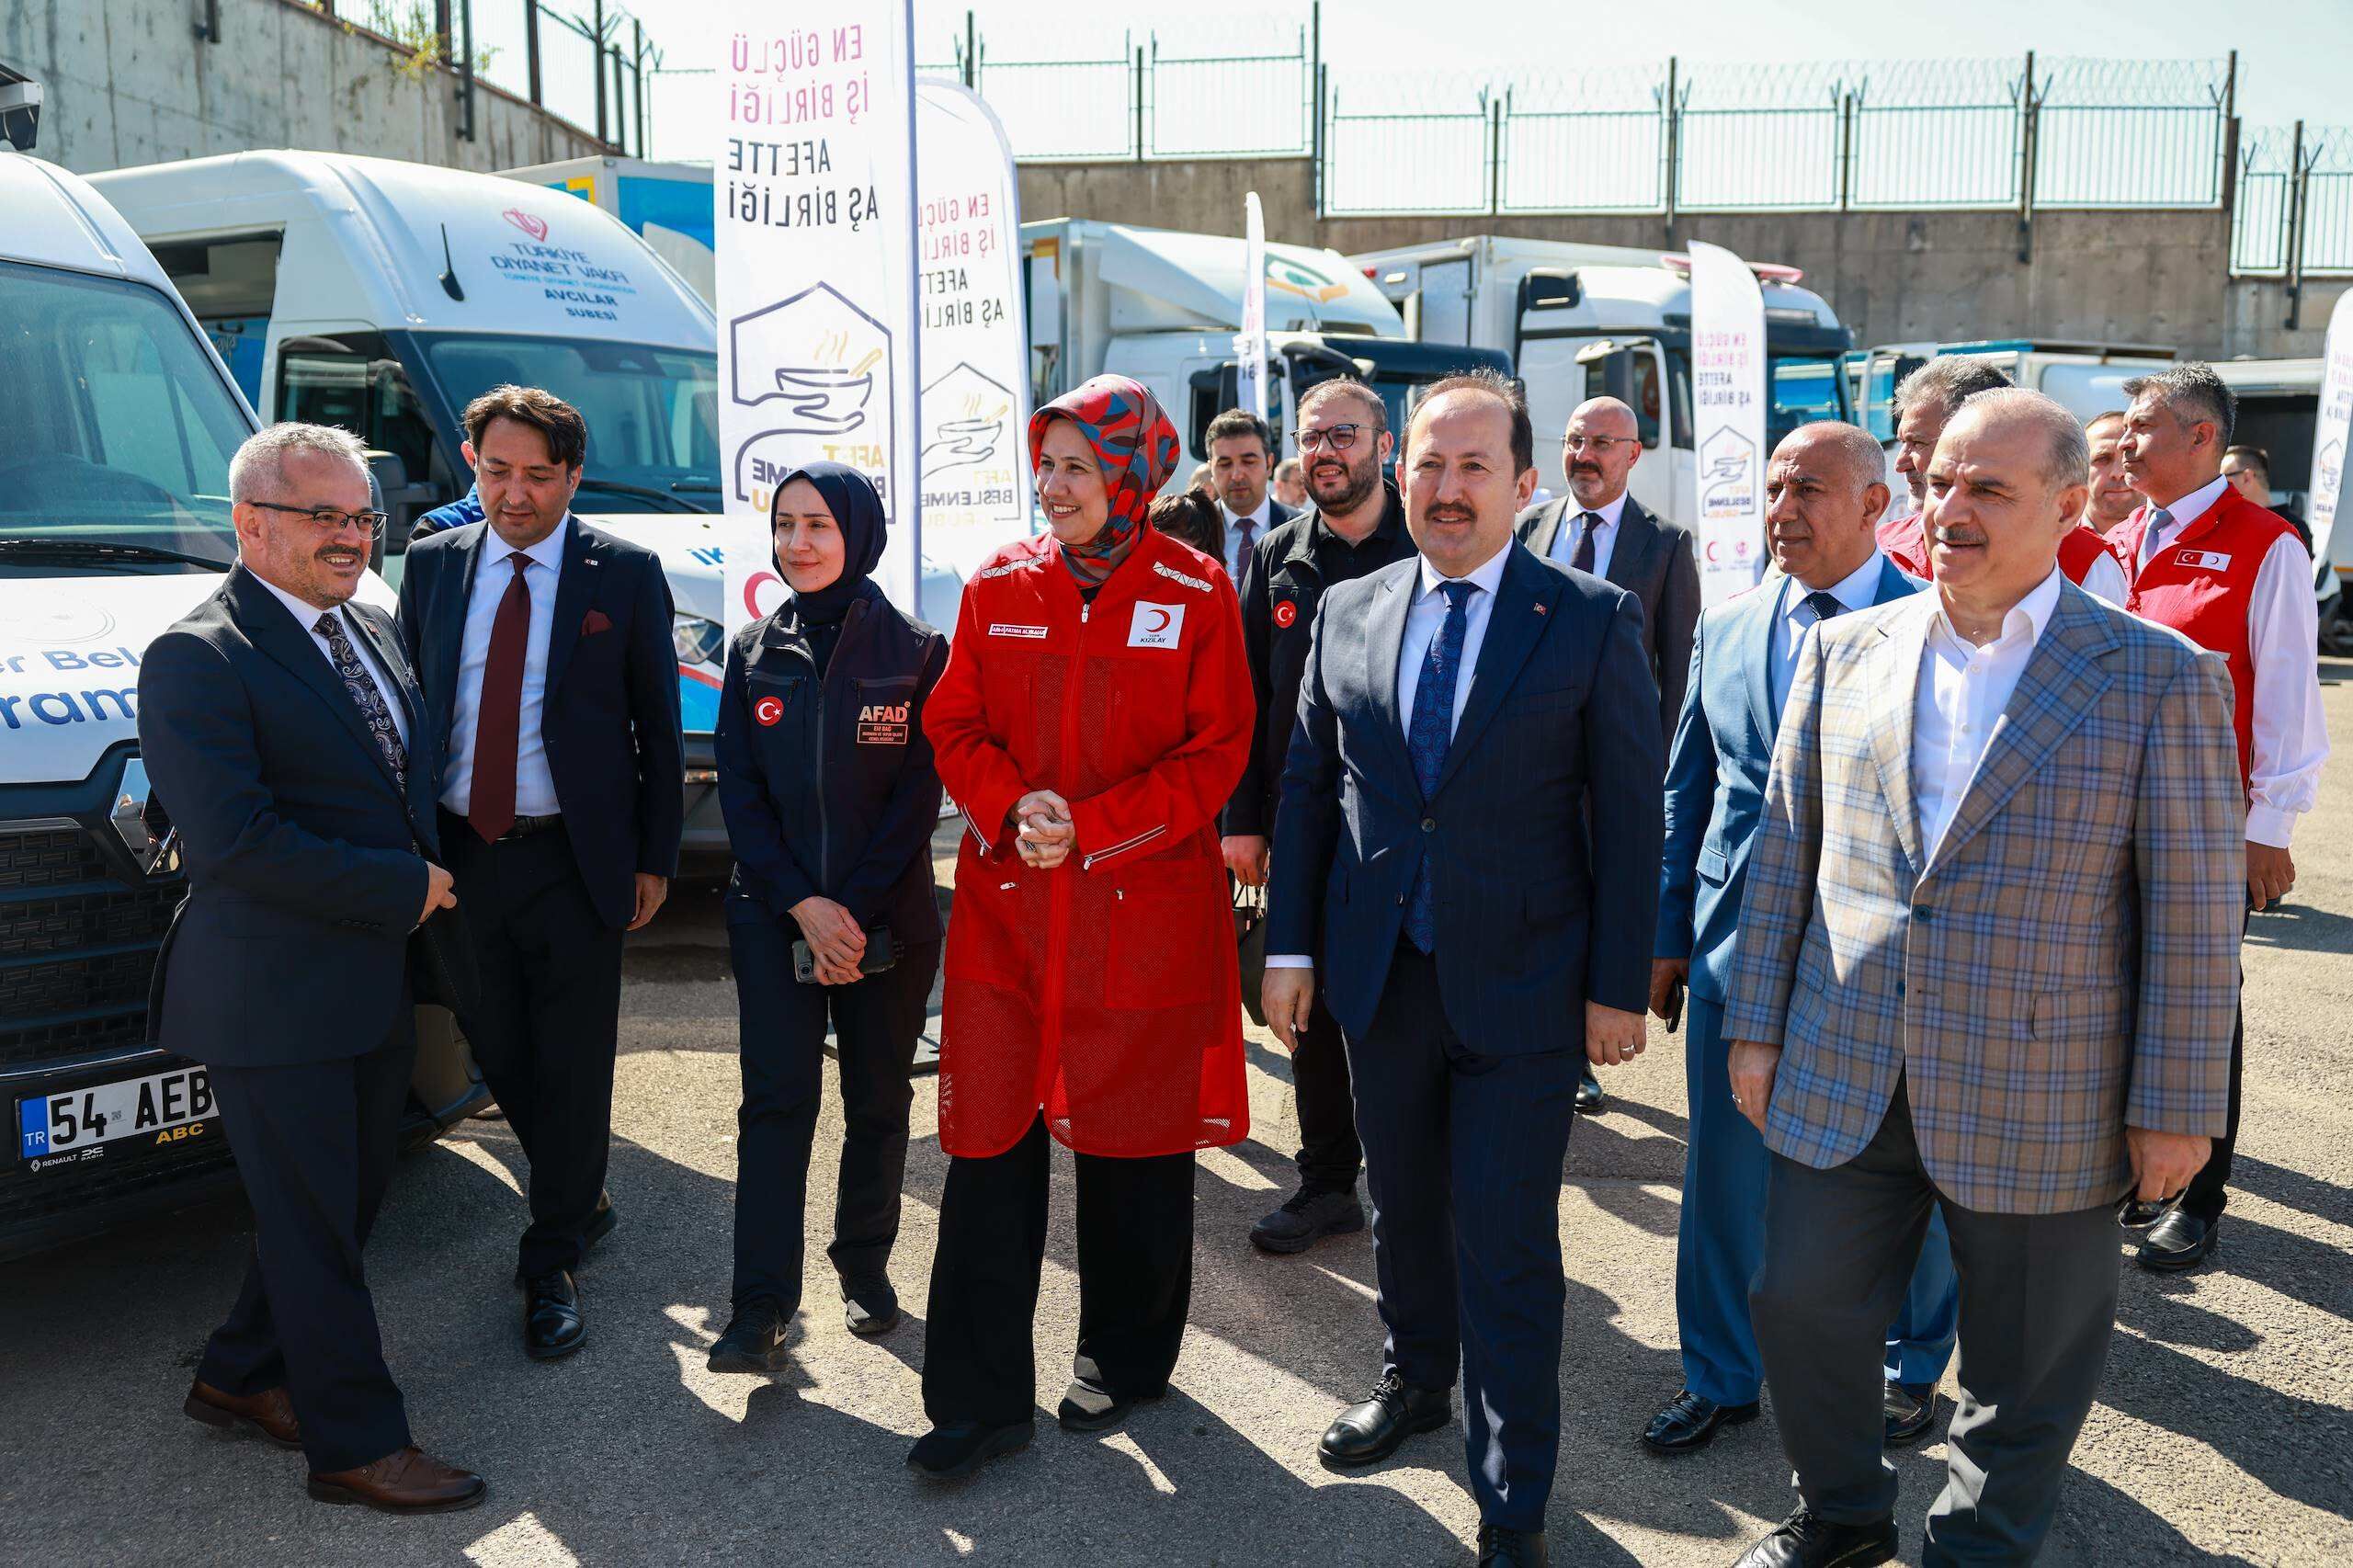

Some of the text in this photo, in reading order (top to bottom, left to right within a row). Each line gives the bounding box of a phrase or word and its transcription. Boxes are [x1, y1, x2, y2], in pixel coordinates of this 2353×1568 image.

[491, 255, 572, 276] DİYANET
[544, 288, 619, 306] AVCILAR
[0, 655, 25, 674] r
[858, 705, 908, 722] AFAD
[50, 1071, 212, 1145] 54 AEB
[25, 1131, 46, 1146] TR
[155, 1123, 204, 1145] ABC
[42, 1154, 78, 1168] RENAULT
